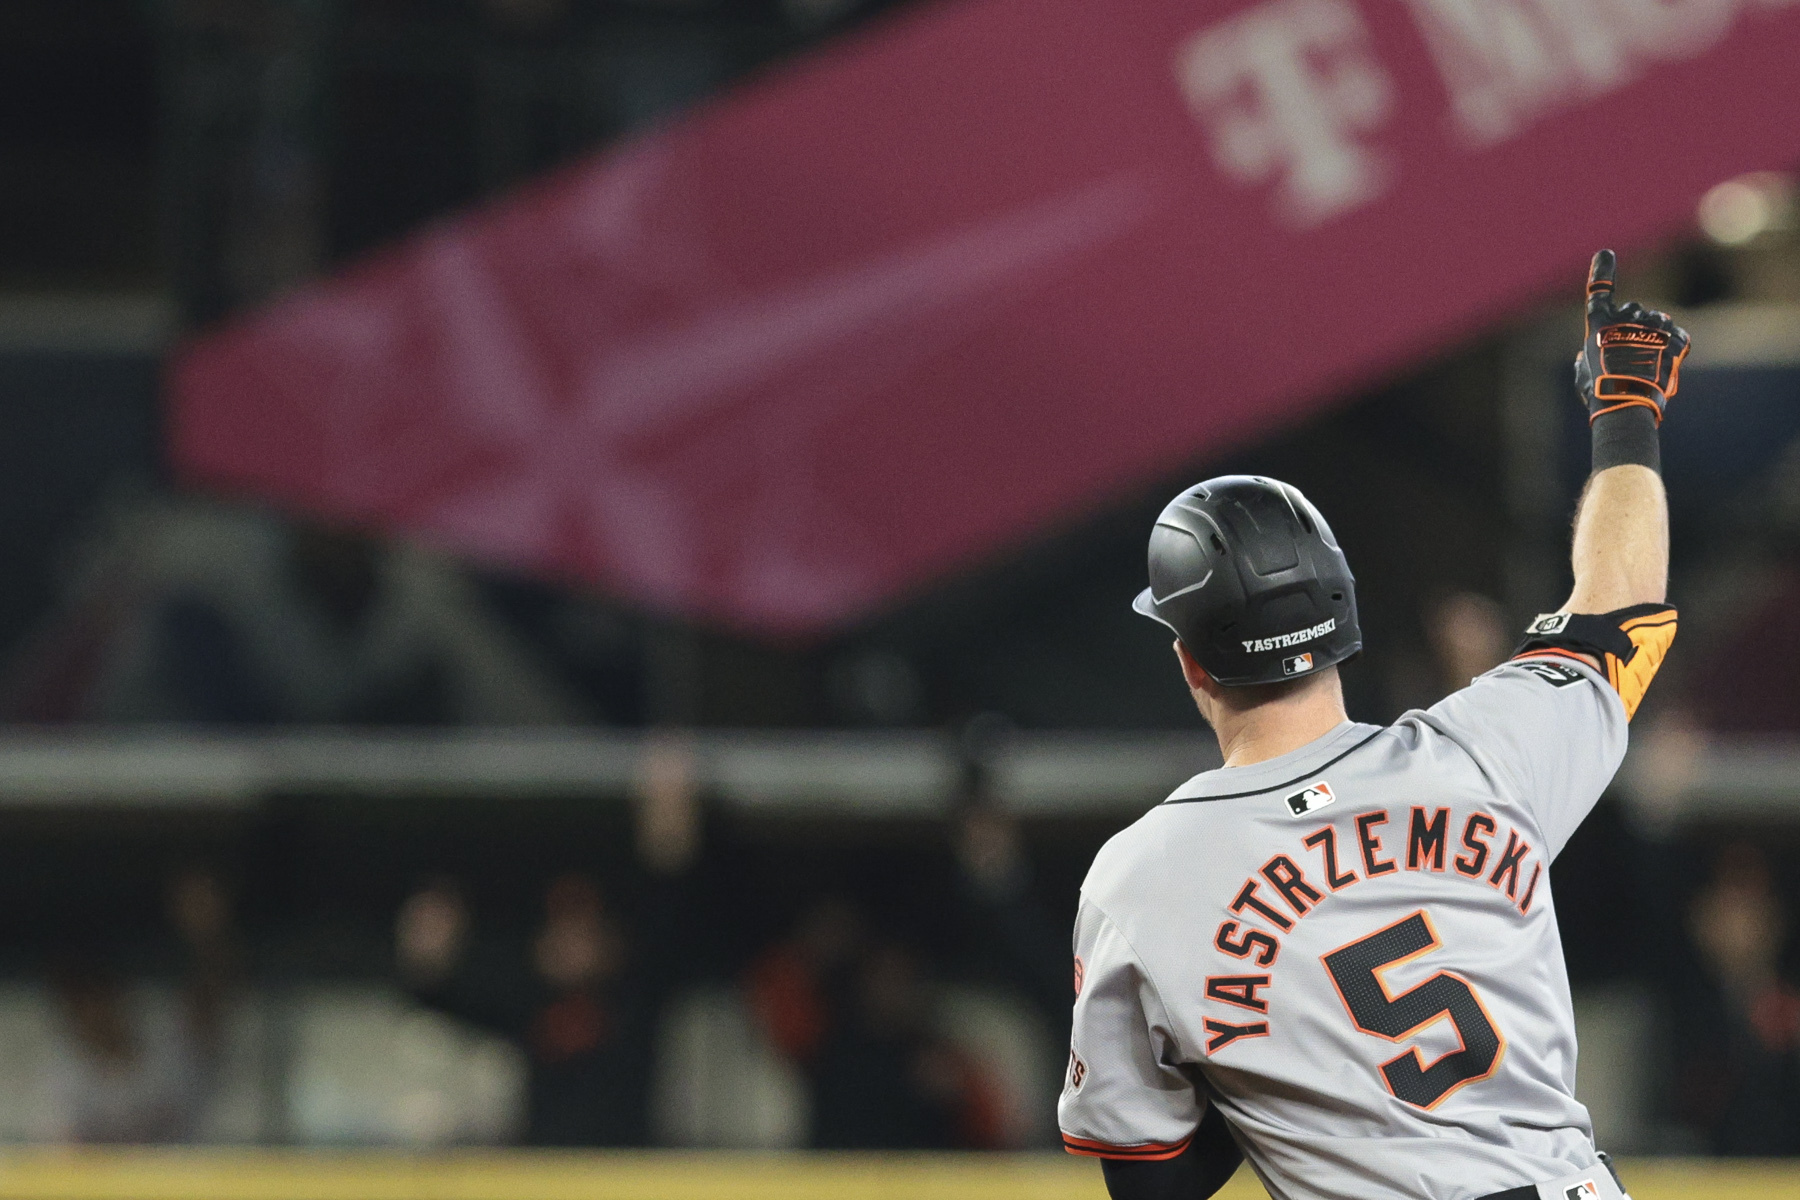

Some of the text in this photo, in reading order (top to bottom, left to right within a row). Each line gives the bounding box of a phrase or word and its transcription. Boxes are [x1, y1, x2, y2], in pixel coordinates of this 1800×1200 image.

[1242, 618, 1336, 653] YASTRZEMSKI
[1203, 806, 1541, 1056] YASTRZEMSKI
[1320, 909, 1506, 1110] 5
